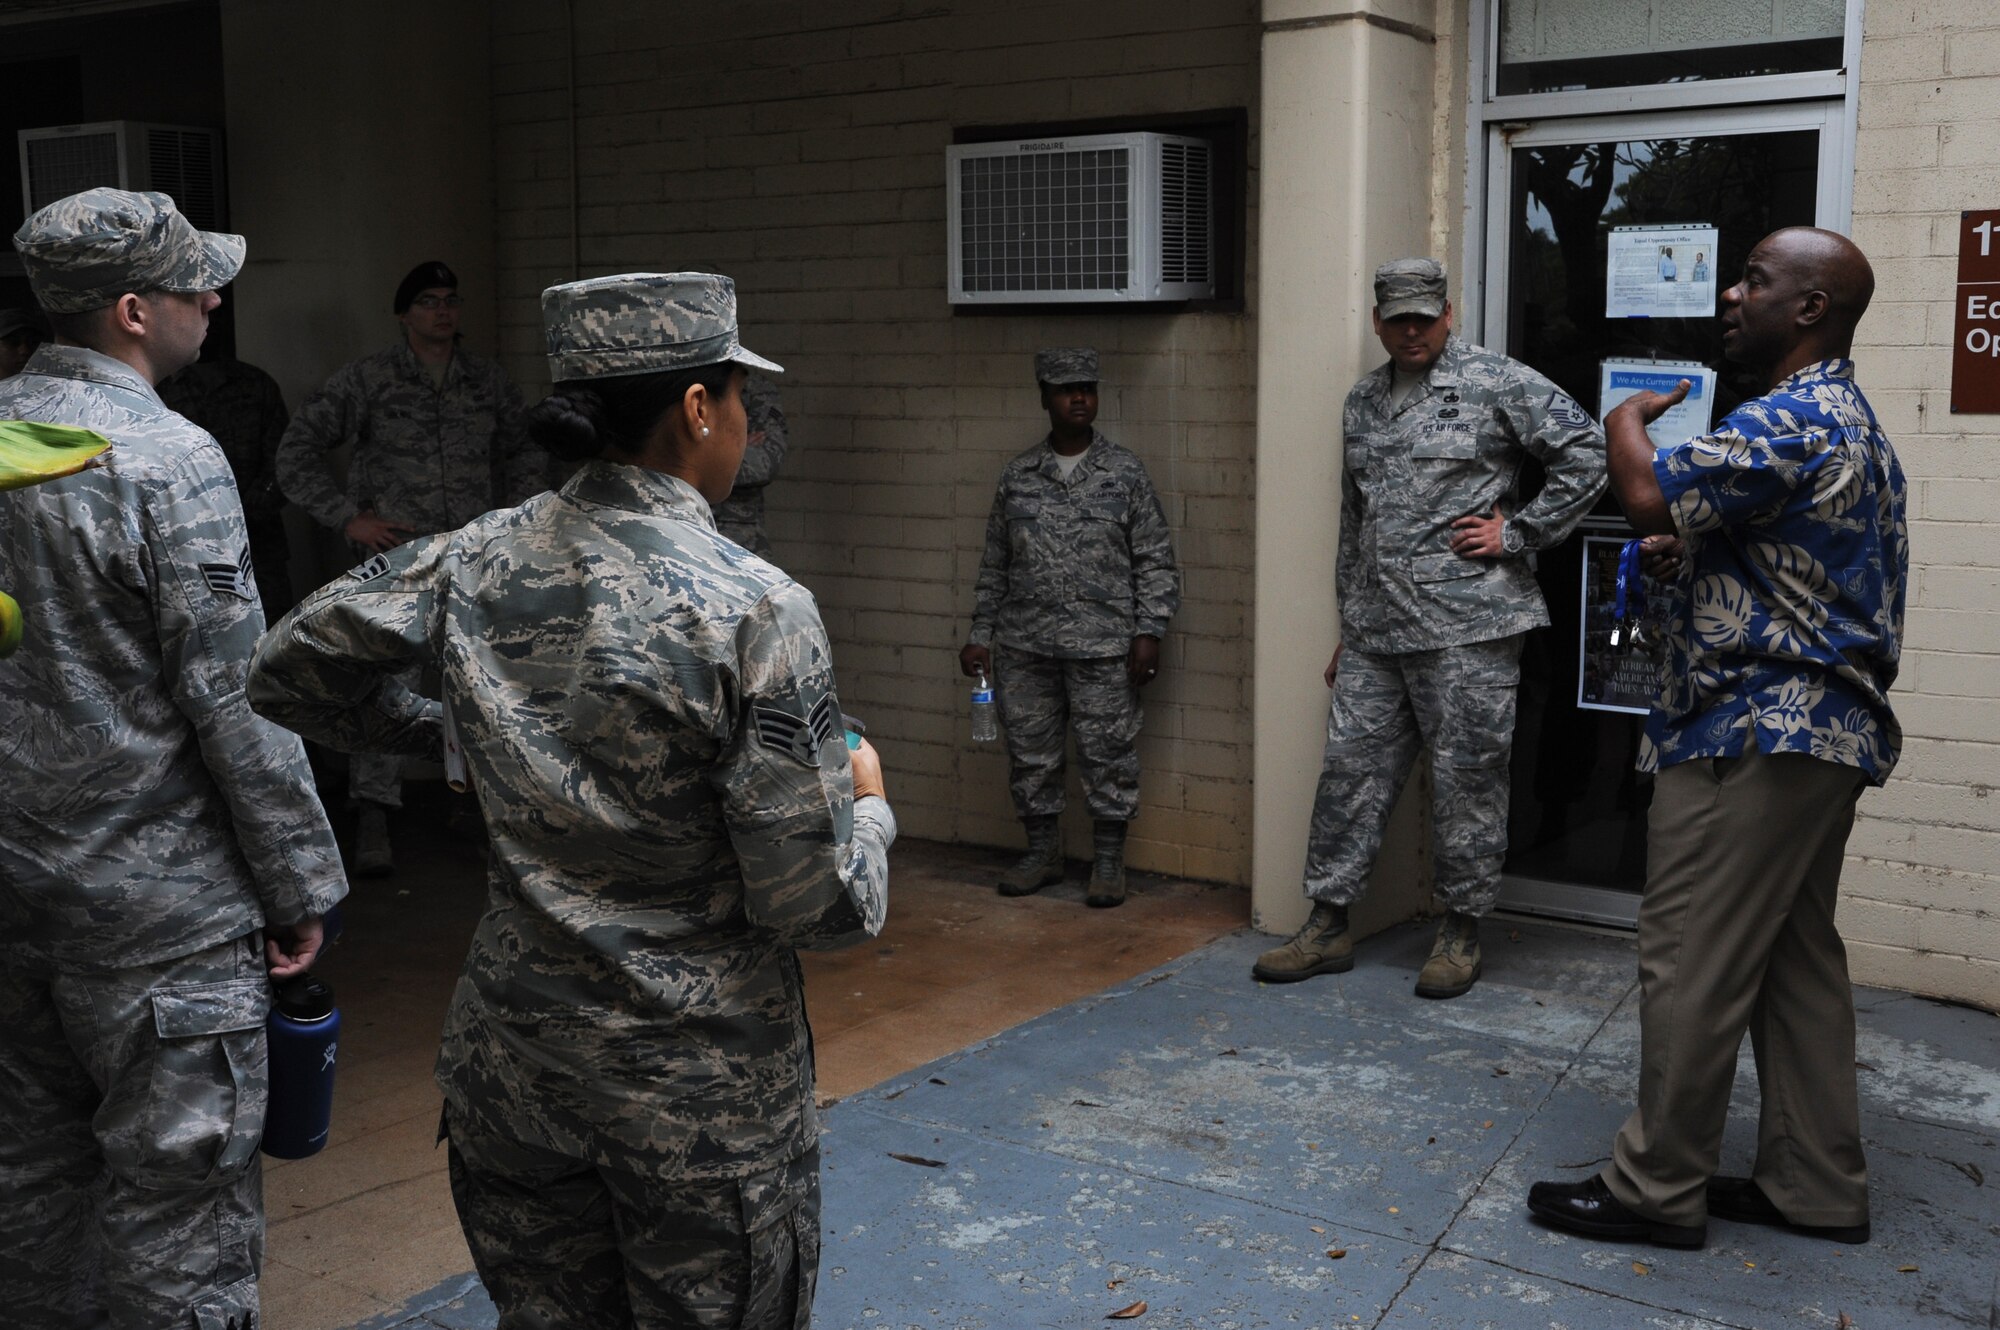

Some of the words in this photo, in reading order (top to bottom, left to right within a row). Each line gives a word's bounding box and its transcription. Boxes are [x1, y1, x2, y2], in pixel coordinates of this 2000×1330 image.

[1020, 142, 1065, 152] FRIGIDAIRE
[1616, 377, 1630, 385] We
[1434, 423, 1447, 433] AIR
[1447, 423, 1471, 433] FORCE
[1619, 659, 1656, 673] AFRICAN
[1614, 682, 1638, 695] TIMES
